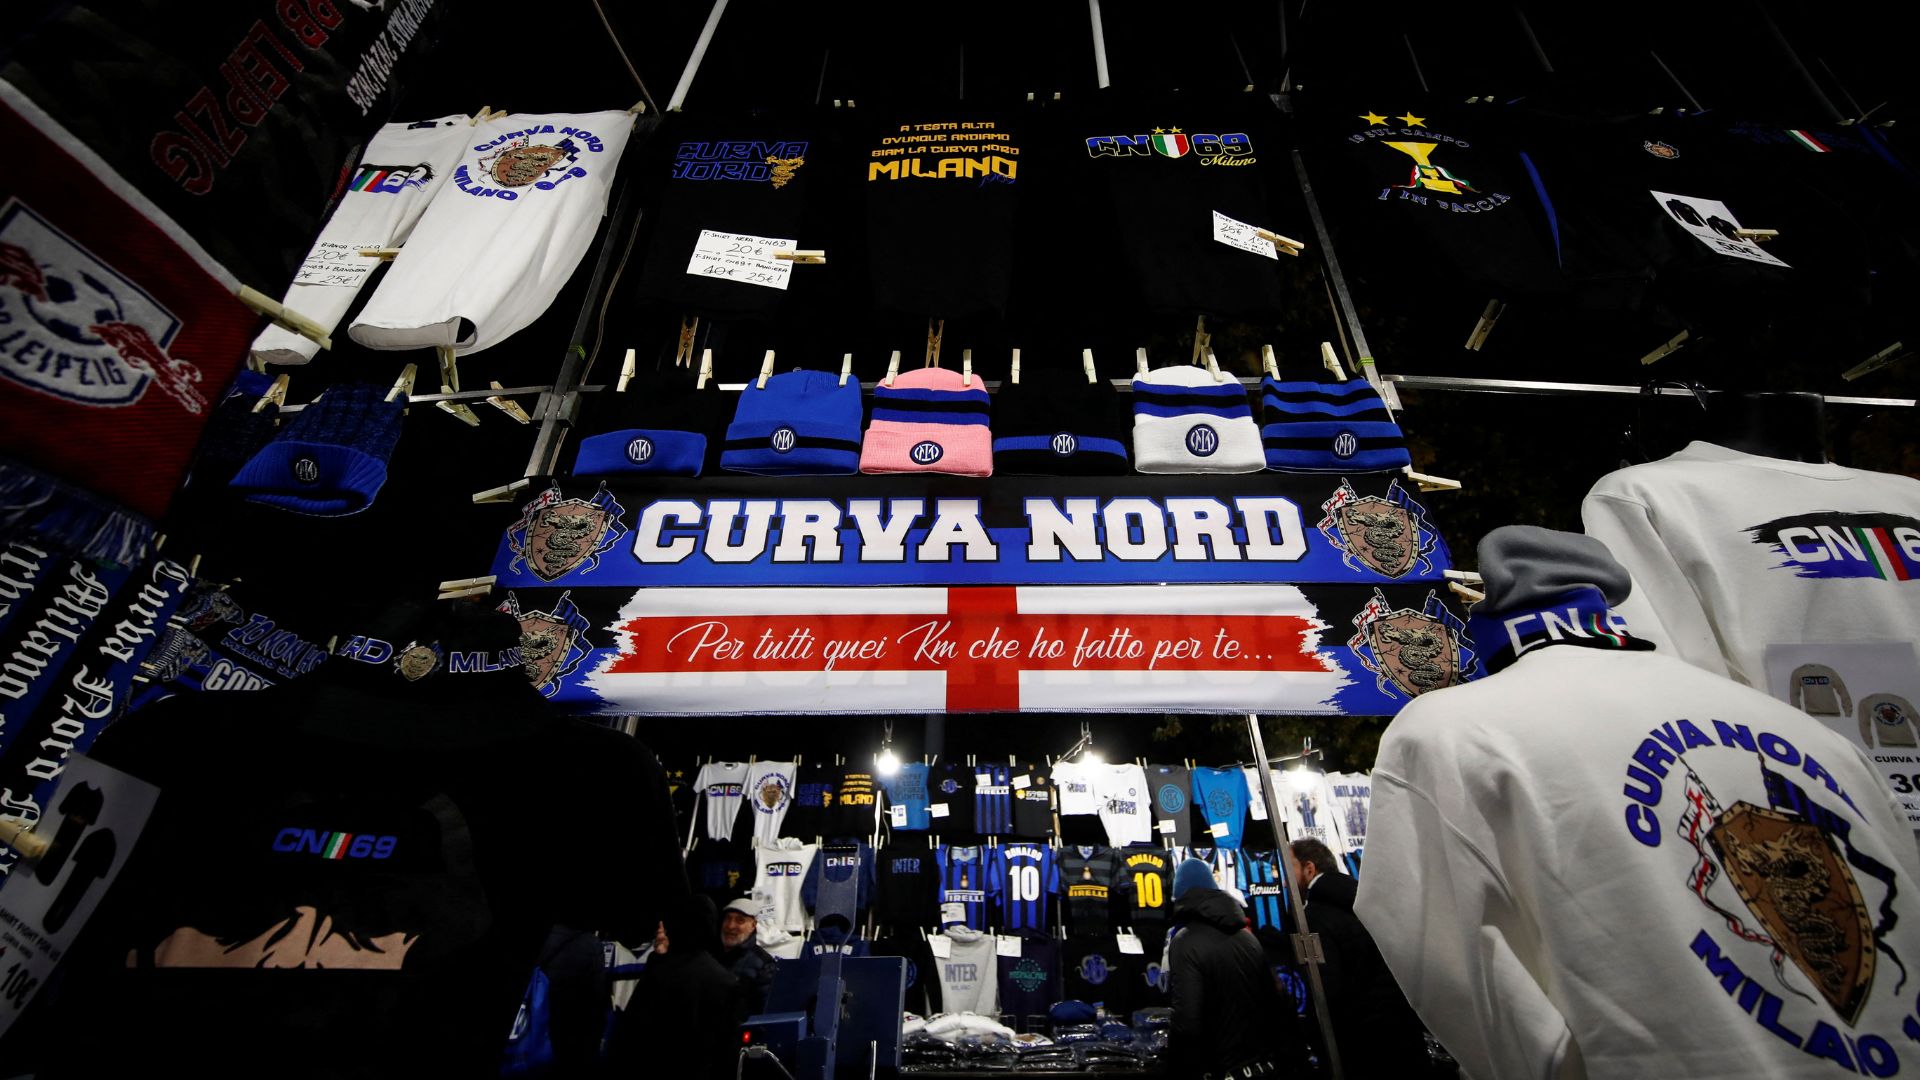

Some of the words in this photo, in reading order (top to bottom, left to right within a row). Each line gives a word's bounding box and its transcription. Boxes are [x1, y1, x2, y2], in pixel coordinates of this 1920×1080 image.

[346, 31, 399, 117] 2024/2025
[150, 19, 304, 196] LEIPZIG
[914, 122, 958, 131] TESTA
[962, 121, 995, 130] ALTA
[473, 124, 556, 152] CURVA
[559, 126, 604, 153] NORD
[882, 134, 947, 145] OVUNQUE
[951, 133, 1010, 141] ANDIAMO
[1400, 128, 1470, 149] CAMPO
[677, 141, 809, 161] CURVA
[871, 147, 905, 158] SIAM
[908, 145, 927, 154] LA
[930, 145, 978, 154] CURVA
[981, 143, 1020, 156] NORD
[1200, 155, 1257, 167] Milano
[868, 155, 1018, 181] MILANO
[453, 164, 519, 201] MILANO
[1399, 190, 1428, 206] IN
[703, 231, 730, 240] T-SHIRT
[759, 239, 786, 247] CN69
[725, 242, 763, 256] 20€
[307, 249, 350, 261] 20€
[695, 253, 721, 262] T-SHIRT
[703, 265, 735, 277] 40€
[0, 330, 127, 386] LEIPZIG
[631, 498, 999, 564] CURVA
[1023, 496, 1309, 563] NORD
[100, 558, 192, 663] Curva
[0, 560, 110, 700] Milano
[336, 634, 394, 665] RD
[666, 621, 745, 663] Per
[752, 627, 816, 660] tutti
[822, 635, 888, 671] quei
[896, 620, 959, 665] Km
[967, 626, 1020, 659] che
[1028, 626, 1065, 659] ho
[1072, 626, 1145, 669] fatto
[1148, 635, 1204, 671] per
[1211, 627, 1273, 660] te...
[25, 663, 115, 782] Nord
[1874, 755, 1913, 763] CURVA
[1623, 719, 1717, 848] CURVA
[839, 793, 874, 807] MILANO
[892, 857, 921, 874] INTER
[1009, 865, 1040, 902] 10
[1133, 871, 1164, 908] 10
[1249, 883, 1281, 895] Fiorucci
[944, 963, 978, 983] INTER
[1, 962, 37, 1009] 10€
